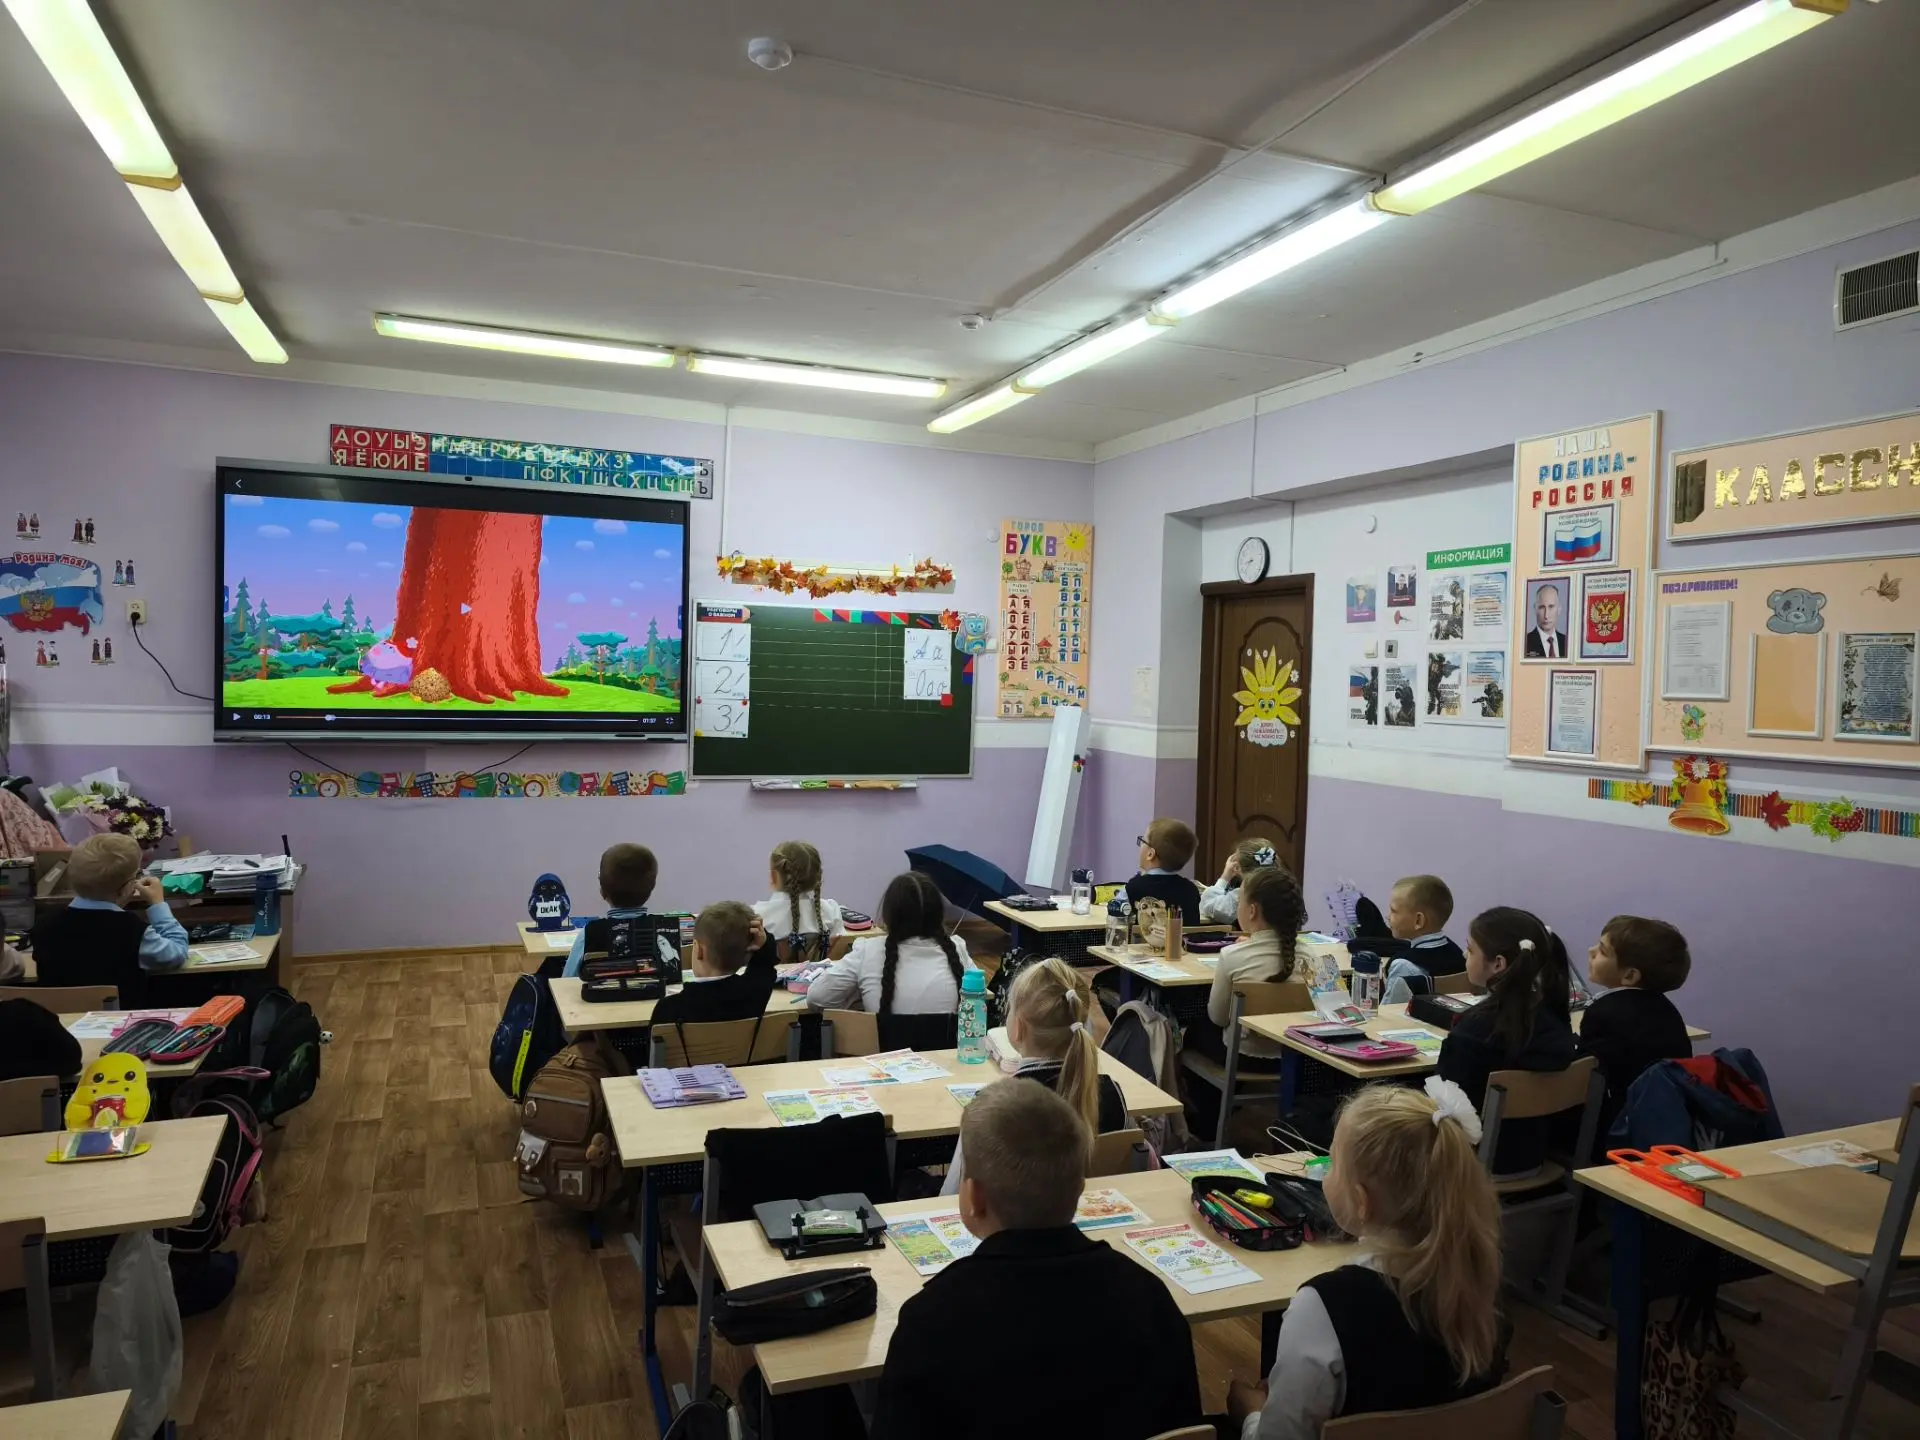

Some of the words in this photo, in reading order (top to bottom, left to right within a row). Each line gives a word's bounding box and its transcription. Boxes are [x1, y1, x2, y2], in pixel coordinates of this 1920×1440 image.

[1555, 429, 1611, 457] НАША
[1538, 452, 1637, 485] РОДИНА-
[1532, 476, 1633, 509] РОССИЯ
[1005, 533, 1058, 556] БУКВ
[1433, 547, 1504, 564] ИНФОРМАЦИЯ
[1662, 579, 1738, 594] ПОЗДРАВЛЯЕМ!
[714, 665, 733, 693] 2
[713, 704, 732, 732] 3
